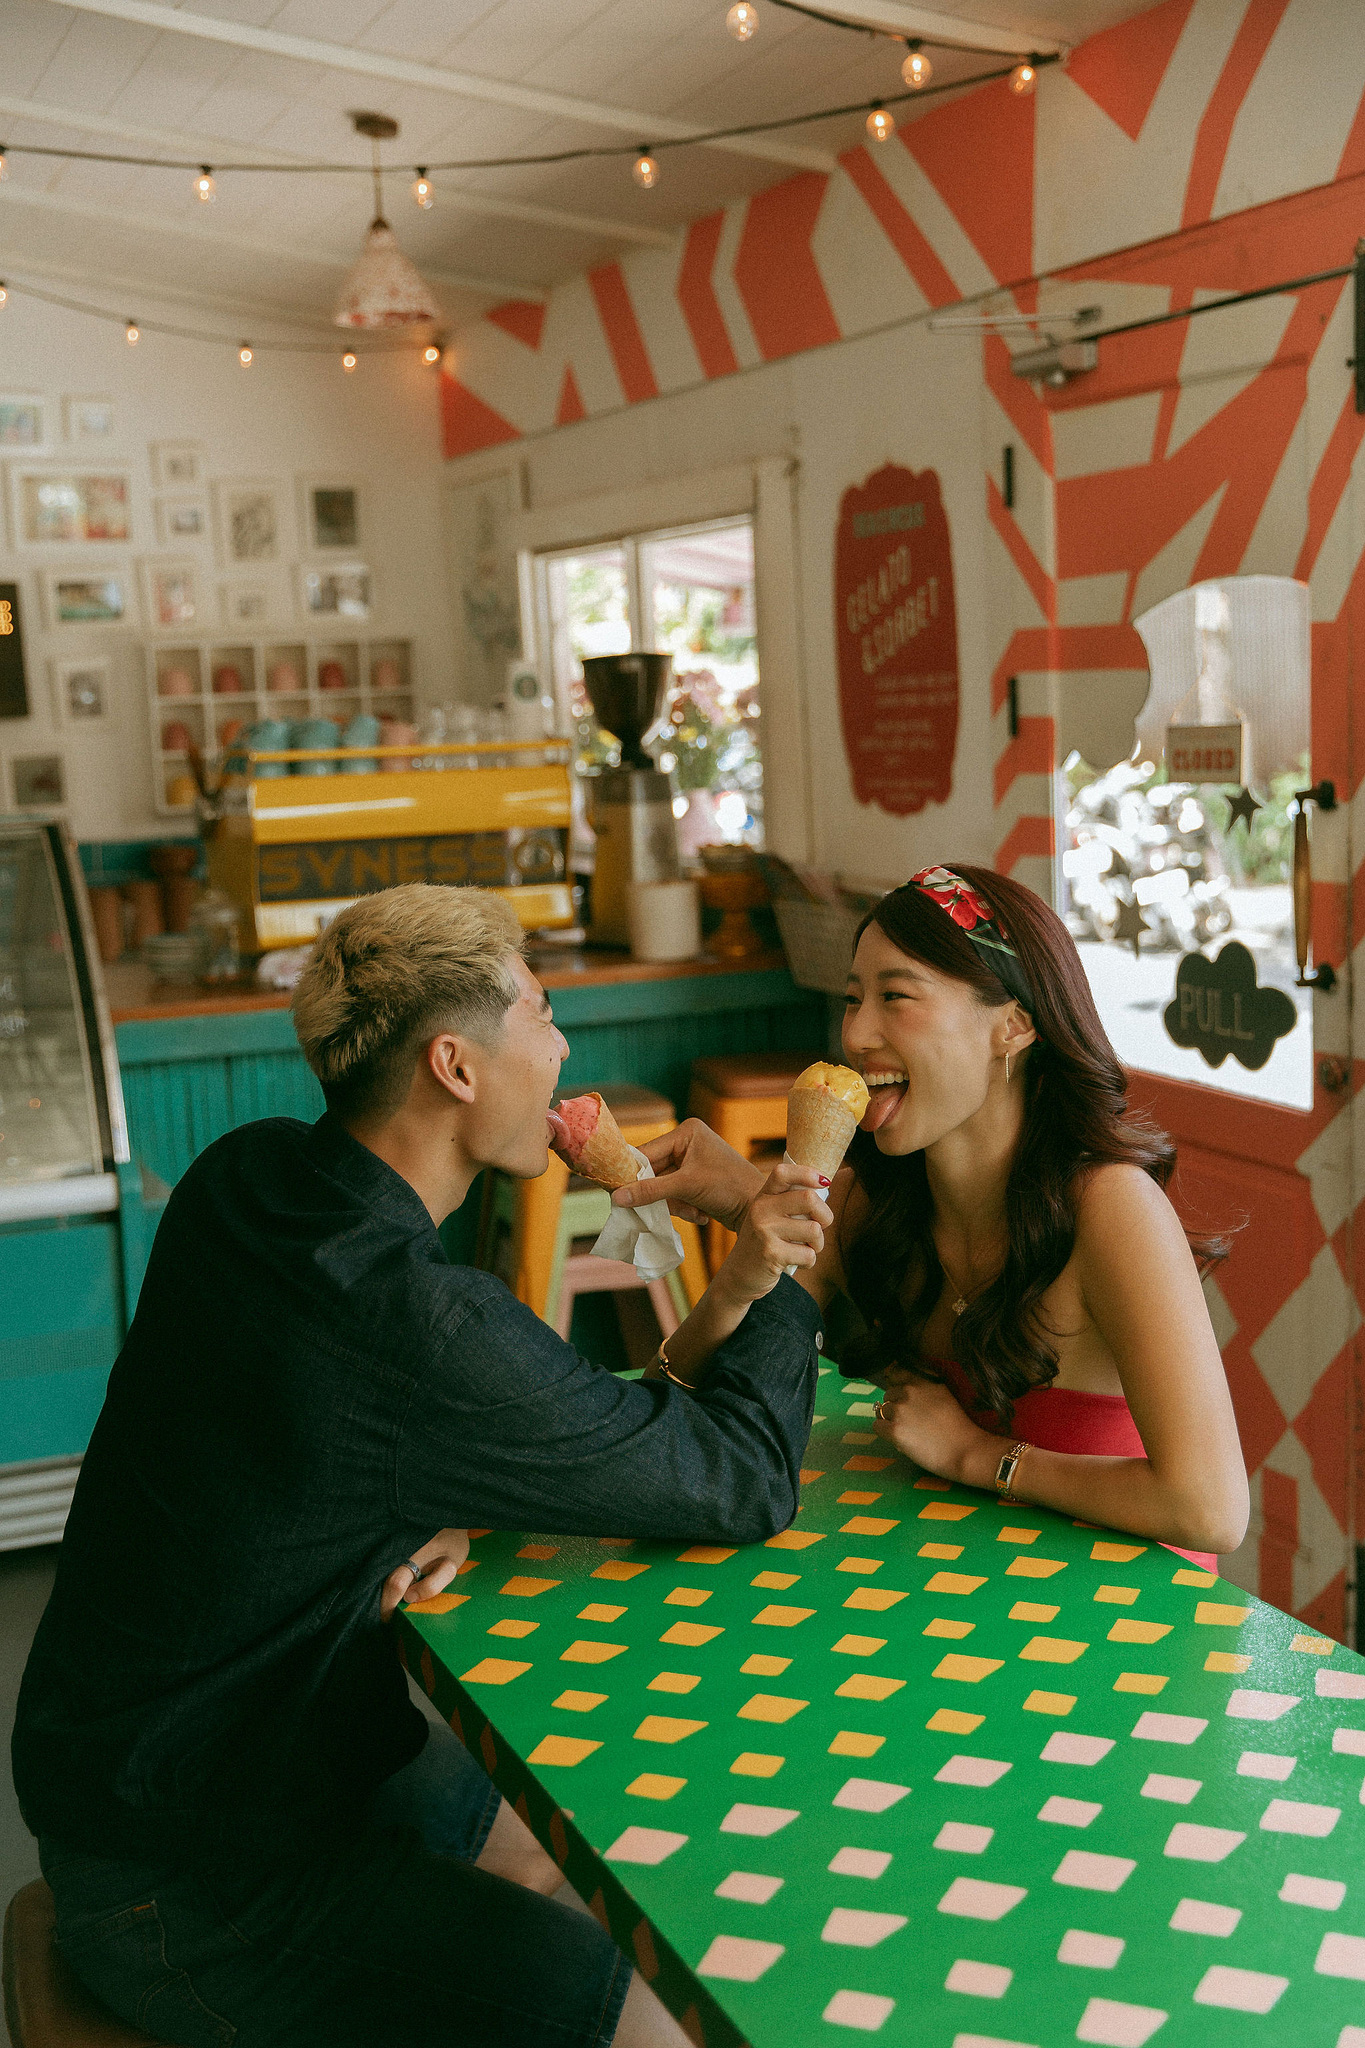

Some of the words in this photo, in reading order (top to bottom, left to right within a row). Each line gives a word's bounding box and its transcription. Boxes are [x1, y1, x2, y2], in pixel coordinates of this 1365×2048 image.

[847, 545, 911, 634] GELATO
[1172, 748, 1235, 770] CLOSED
[262, 838, 554, 892] SYNESSO
[1180, 983, 1255, 1041] PULL
